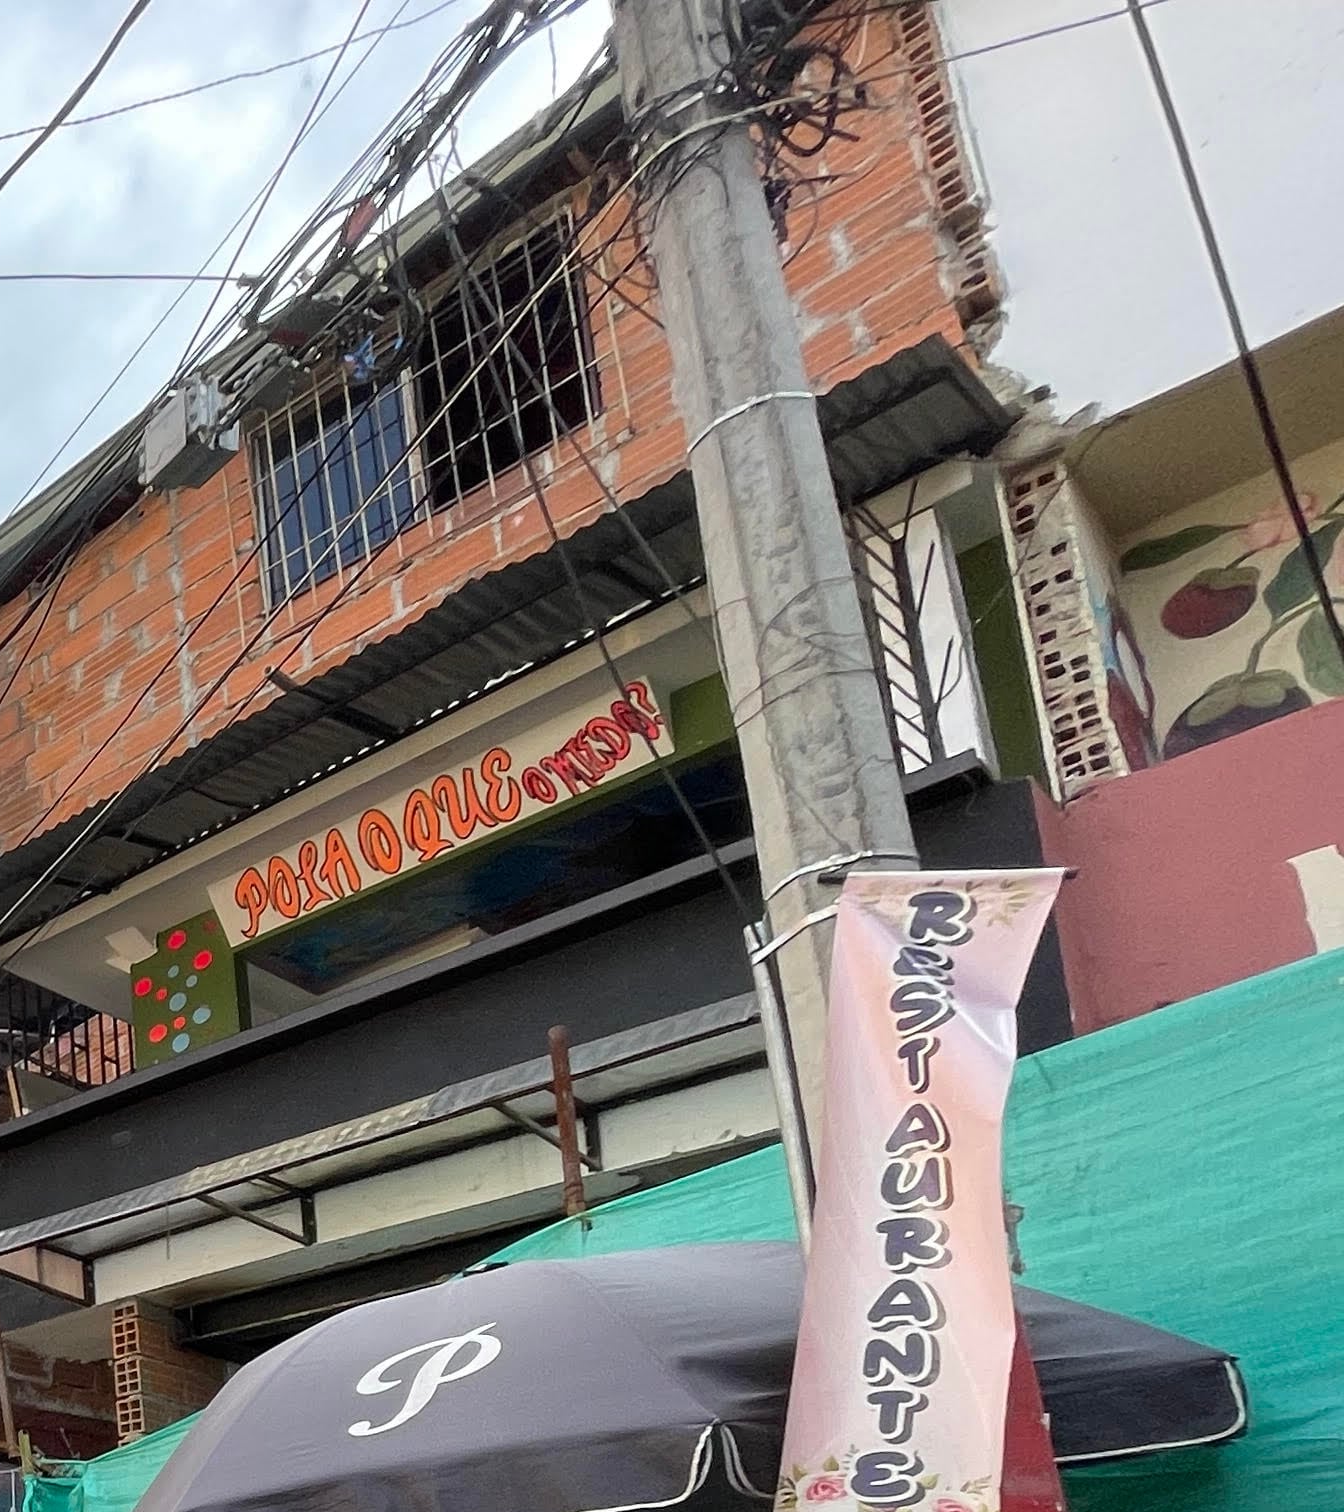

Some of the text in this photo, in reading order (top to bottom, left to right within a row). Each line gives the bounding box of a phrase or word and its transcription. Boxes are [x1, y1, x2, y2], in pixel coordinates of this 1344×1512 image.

[234, 828, 362, 938] POLA
[403, 746, 521, 863] QUE
[849, 889, 974, 1509] RESTAURANTE
